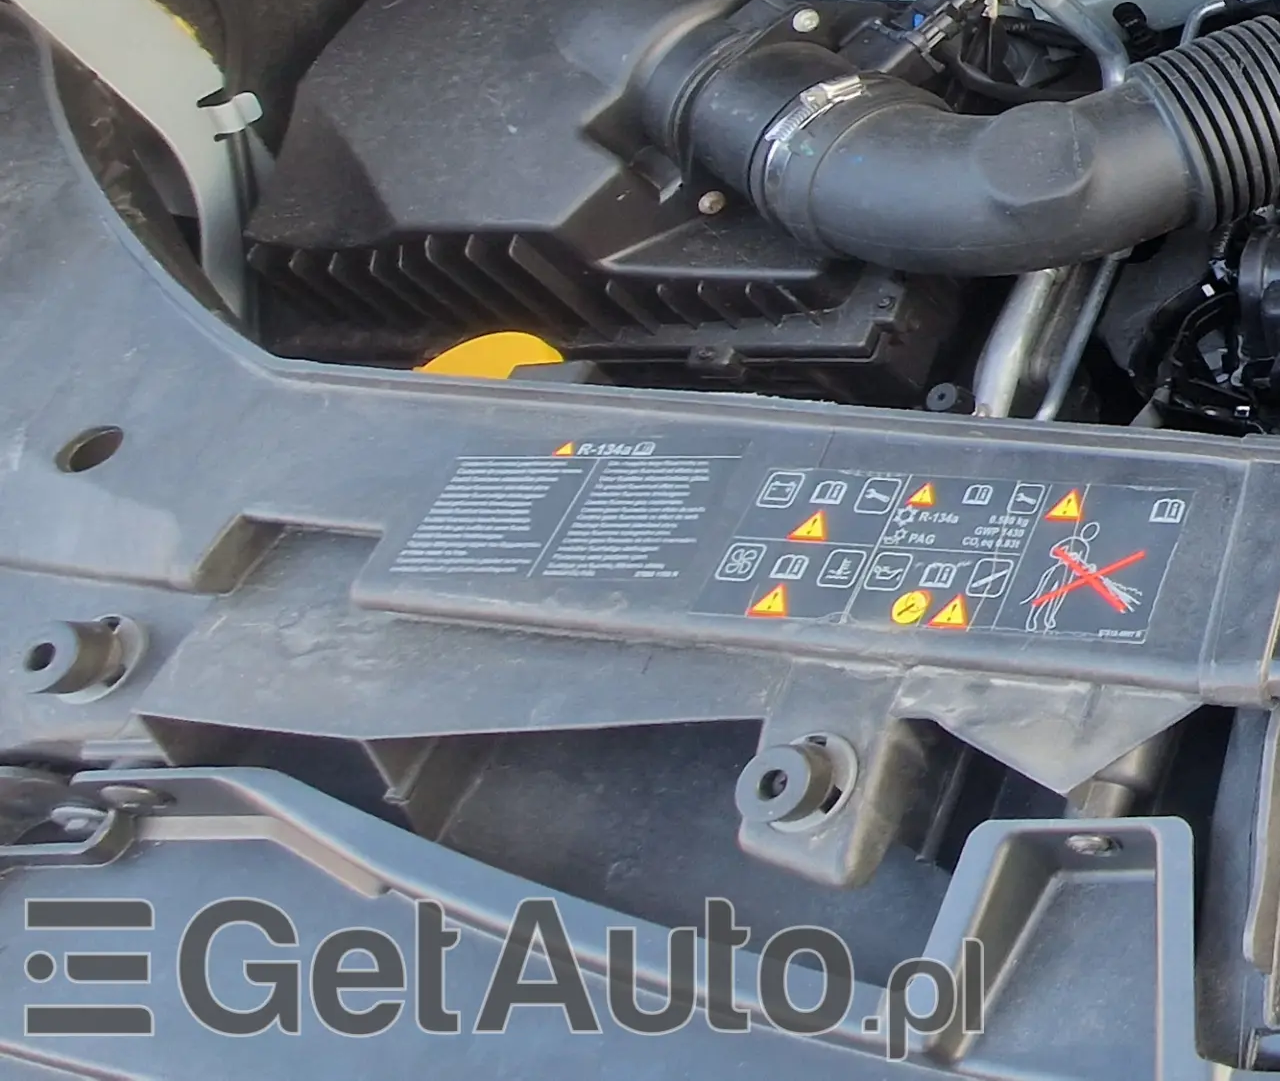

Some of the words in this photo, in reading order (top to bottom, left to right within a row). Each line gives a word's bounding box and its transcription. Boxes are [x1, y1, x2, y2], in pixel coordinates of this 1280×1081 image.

[576, 443, 632, 456] R-134a
[918, 511, 960, 524] R-134a
[974, 526, 1000, 536] GWP
[908, 532, 936, 545] PAG
